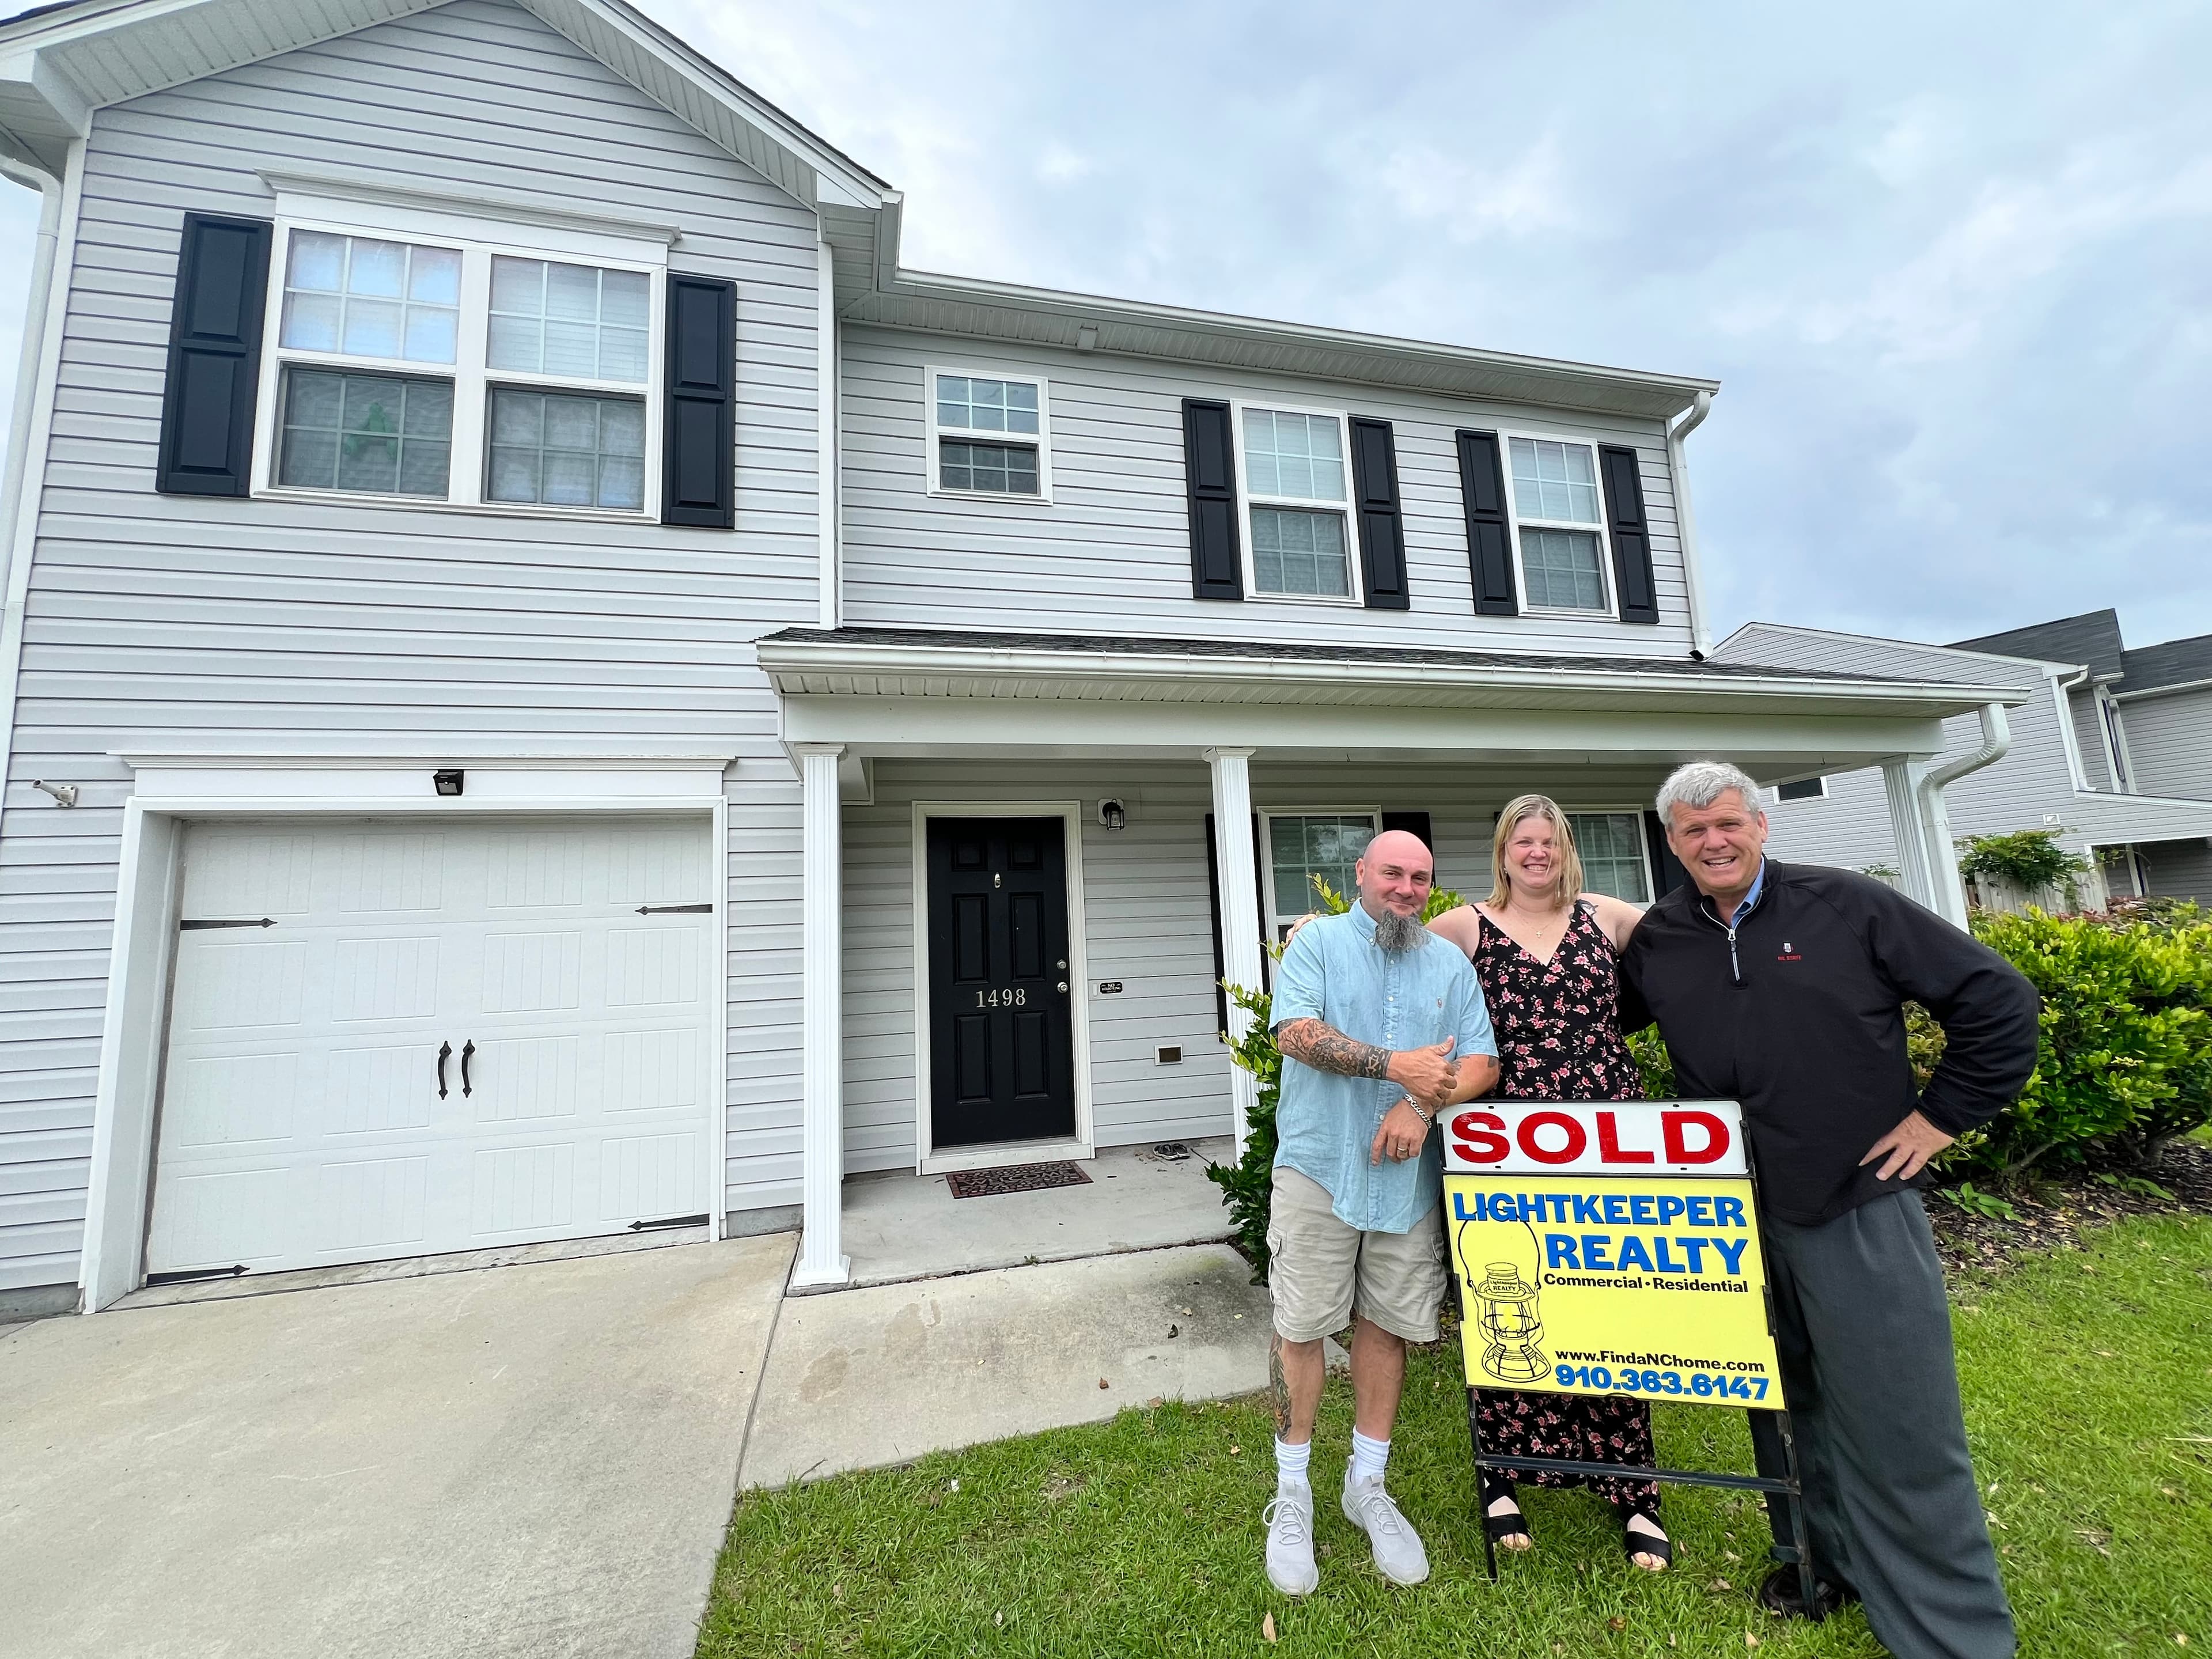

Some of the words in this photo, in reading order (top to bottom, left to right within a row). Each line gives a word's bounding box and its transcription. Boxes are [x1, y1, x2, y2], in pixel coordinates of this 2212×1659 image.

[976, 988, 1025, 1007] 1498
[1451, 1111, 1730, 1164] SOLD
[1453, 1192, 1747, 1227] LIGHTKEEPER
[1544, 1234, 1748, 1275] REALTY
[1544, 1273, 1642, 1289] Commercial
[1653, 1277, 1748, 1293] Residential
[1555, 1350, 1765, 1372] www.FindaNChome.com
[1555, 1364, 1770, 1400] 910.363.6147
